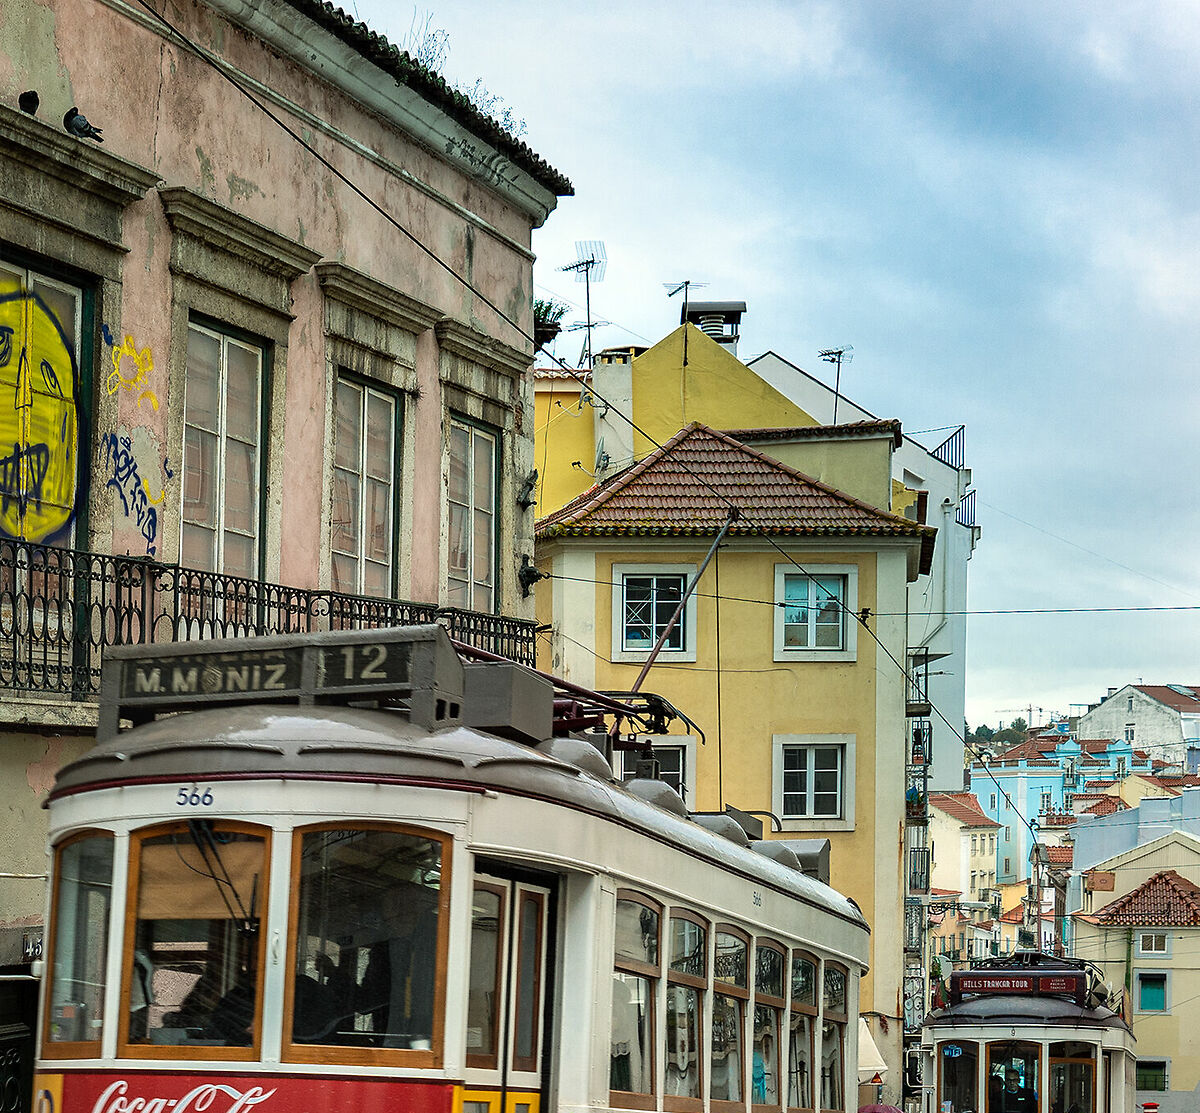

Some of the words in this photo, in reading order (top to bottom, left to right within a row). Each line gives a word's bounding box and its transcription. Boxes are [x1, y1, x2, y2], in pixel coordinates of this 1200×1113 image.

[341, 645, 388, 680] 12
[172, 664, 287, 693] MONIZ
[176, 787, 213, 806] 566
[963, 980, 982, 988] HILLS
[1011, 980, 1029, 988] TOUR
